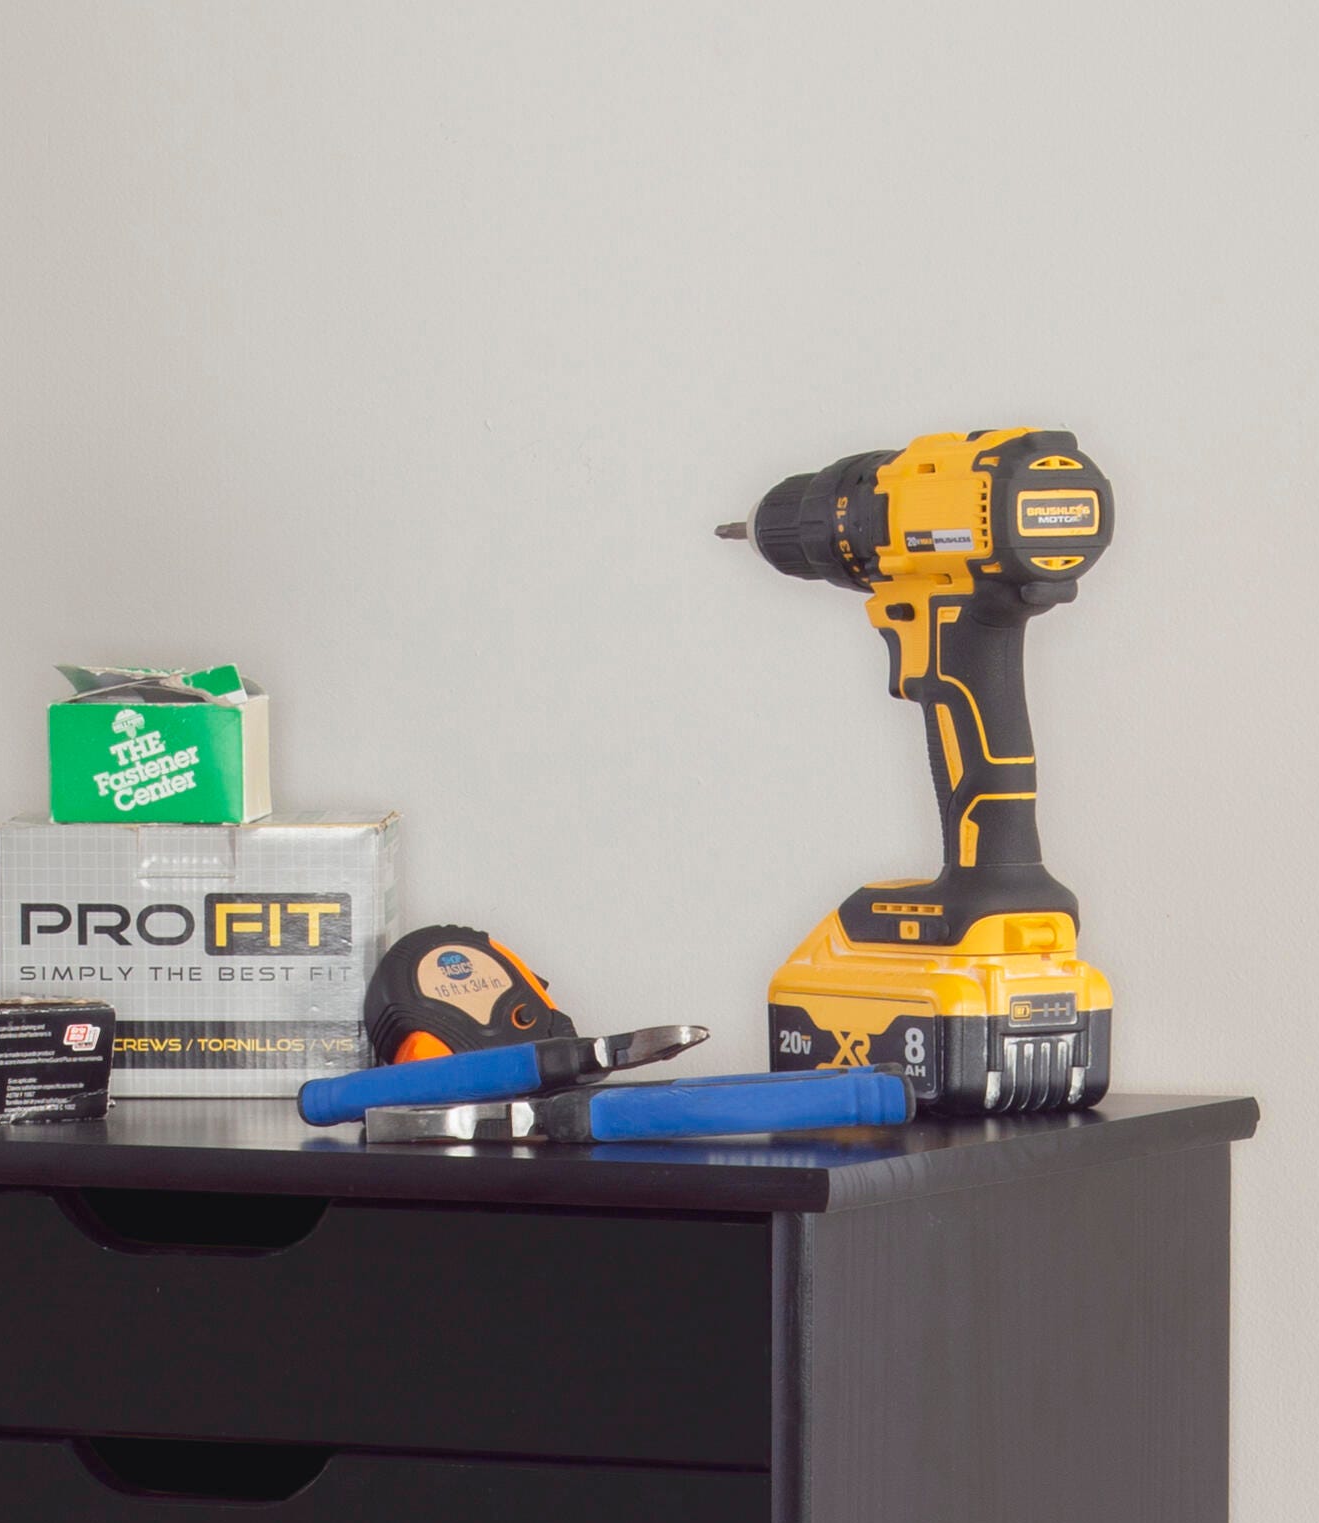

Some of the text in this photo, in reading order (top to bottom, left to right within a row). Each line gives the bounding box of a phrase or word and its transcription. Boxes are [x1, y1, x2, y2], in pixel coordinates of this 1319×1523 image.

[109, 730, 166, 766] THE
[93, 746, 200, 797] Fastener
[114, 770, 197, 811] Center
[20, 966, 353, 981] SIMPLY THE BEST FIT
[435, 984, 450, 997] 16
[113, 1038, 182, 1051] CREWS
[198, 1038, 304, 1051] TORNILLOS
[322, 1038, 353, 1051] VIS
[905, 1027, 925, 1064] 8
[904, 1065, 926, 1077] AH
